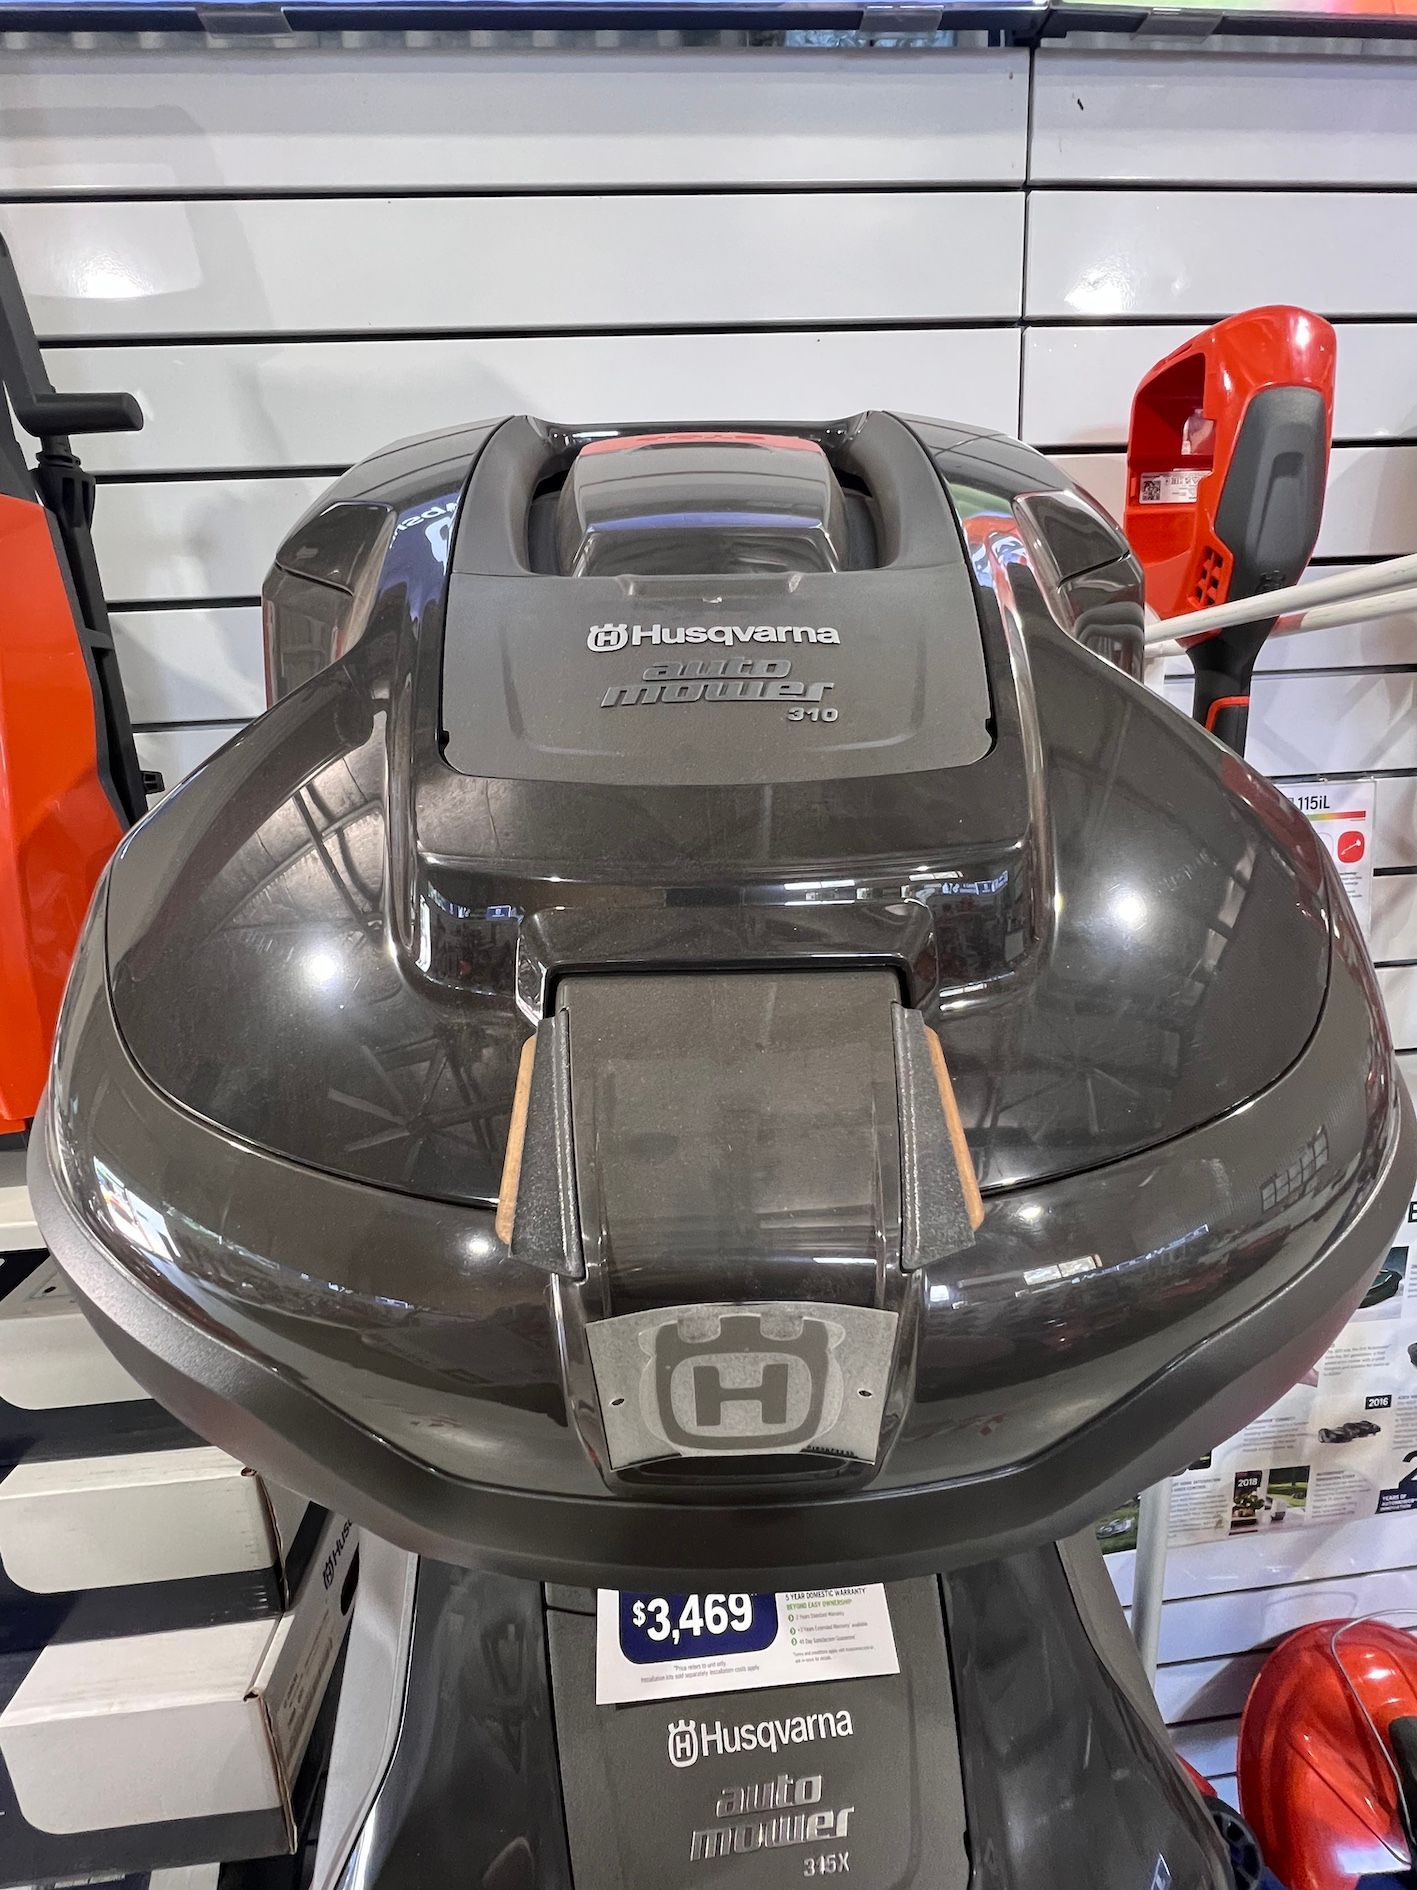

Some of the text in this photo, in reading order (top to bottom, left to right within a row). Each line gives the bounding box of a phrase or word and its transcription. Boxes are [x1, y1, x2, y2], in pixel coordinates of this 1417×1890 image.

[632, 624, 840, 646] Husqvarna
[642, 656, 792, 681] auto
[600, 680, 835, 708] mower
[787, 706, 839, 723] 310
[1297, 795, 1330, 811] 115iL
[1368, 1397, 1389, 1408] 2016
[1237, 1477, 1258, 1488] 2018
[790, 1592, 806, 1601] YEAR
[806, 1590, 834, 1599] DOMESTIC
[835, 1587, 866, 1597] WARRANTY
[700, 1710, 854, 1757] Husqvarna
[716, 1773, 822, 1818] auto
[690, 1806, 855, 1862] mower
[803, 1851, 850, 1878] 315X
